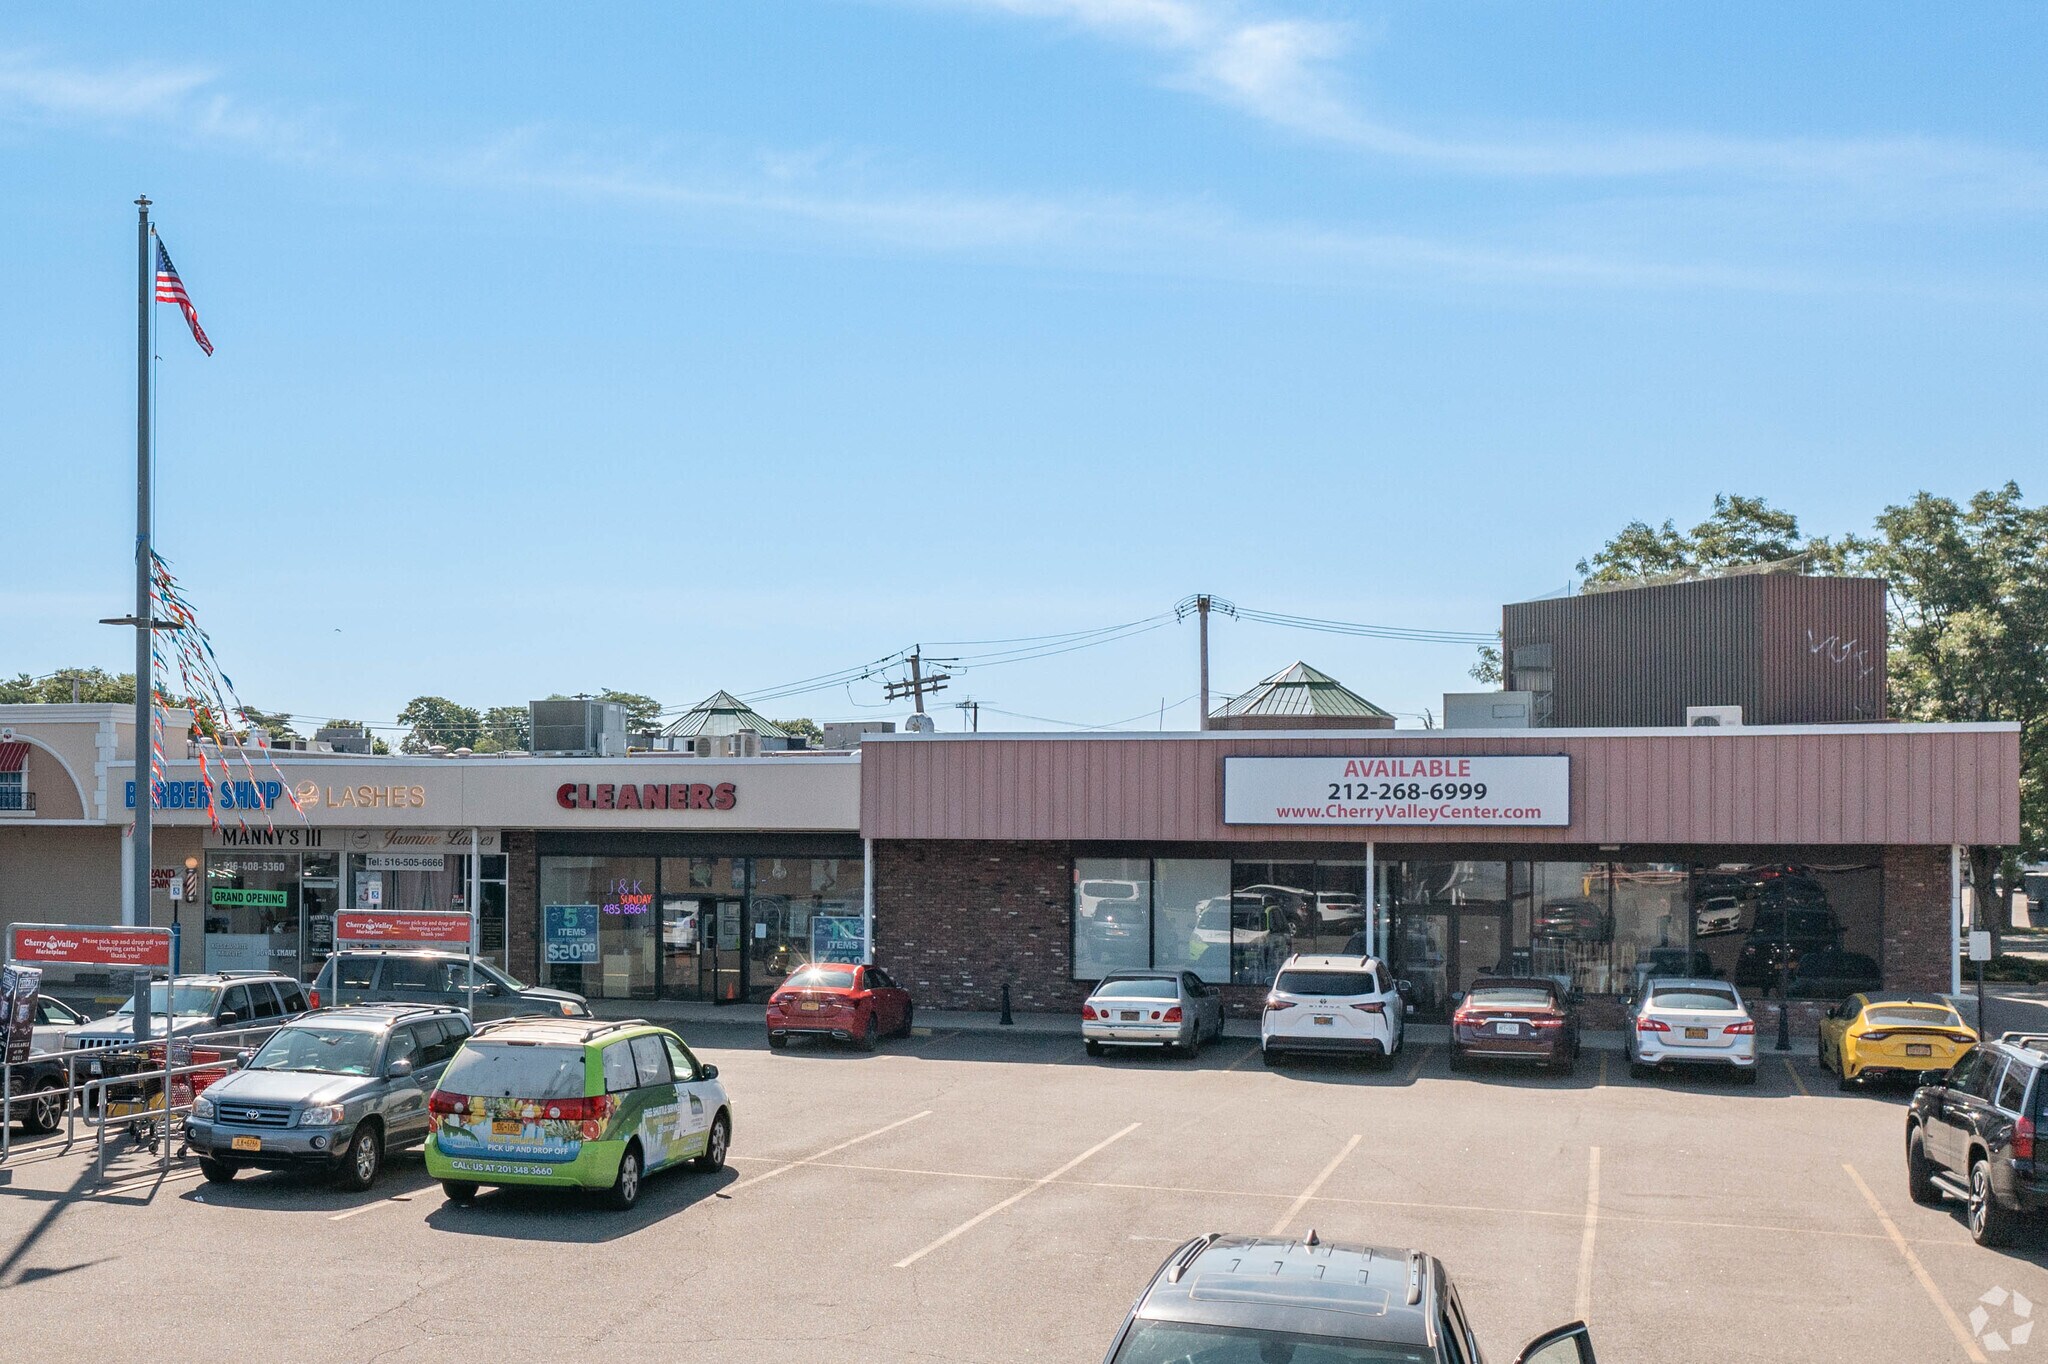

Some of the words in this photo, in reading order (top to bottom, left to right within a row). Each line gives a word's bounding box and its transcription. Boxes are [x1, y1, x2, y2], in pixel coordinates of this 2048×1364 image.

[1343, 760, 1471, 778] AVAILABLE
[125, 780, 214, 810] BRBER
[220, 780, 282, 810] SHOP
[326, 785, 426, 809] LASHES
[556, 782, 737, 811] CLEANERS
[1328, 783, 1488, 800] 212-268-6999
[1276, 804, 1542, 822] www.CherryValleyCenter.com
[222, 828, 299, 846] MANNY'S
[383, 828, 440, 849] Jasmine
[447, 829, 495, 846] Lases
[367, 857, 383, 868] Tel:
[384, 858, 444, 868] 516-505-6666
[607, 879, 614, 896] J
[618, 878, 629, 895] &
[633, 880, 643, 895] K
[214, 891, 244, 903] GRAND
[245, 892, 284, 904] OPENING
[620, 894, 653, 905] SUNDAY
[602, 904, 620, 915] 485
[623, 904, 648, 915] 8864
[563, 908, 578, 928] 5
[345, 921, 366, 930] Cherry
[374, 921, 394, 930] Valley
[557, 928, 587, 937] ITEMS
[24, 938, 47, 949] Cherry
[57, 938, 79, 950] Valley
[99, 938, 111, 946] pick
[131, 939, 145, 947] drop
[827, 941, 858, 949] ITEMS
[515, 1145, 532, 1153] AND
[554, 1147, 569, 1155] OFF
[473, 1163, 484, 1171] US
[485, 1164, 496, 1172] AT
[498, 1165, 512, 1173] 201
[513, 1166, 529, 1174] 348
[531, 1167, 553, 1175] 3660
